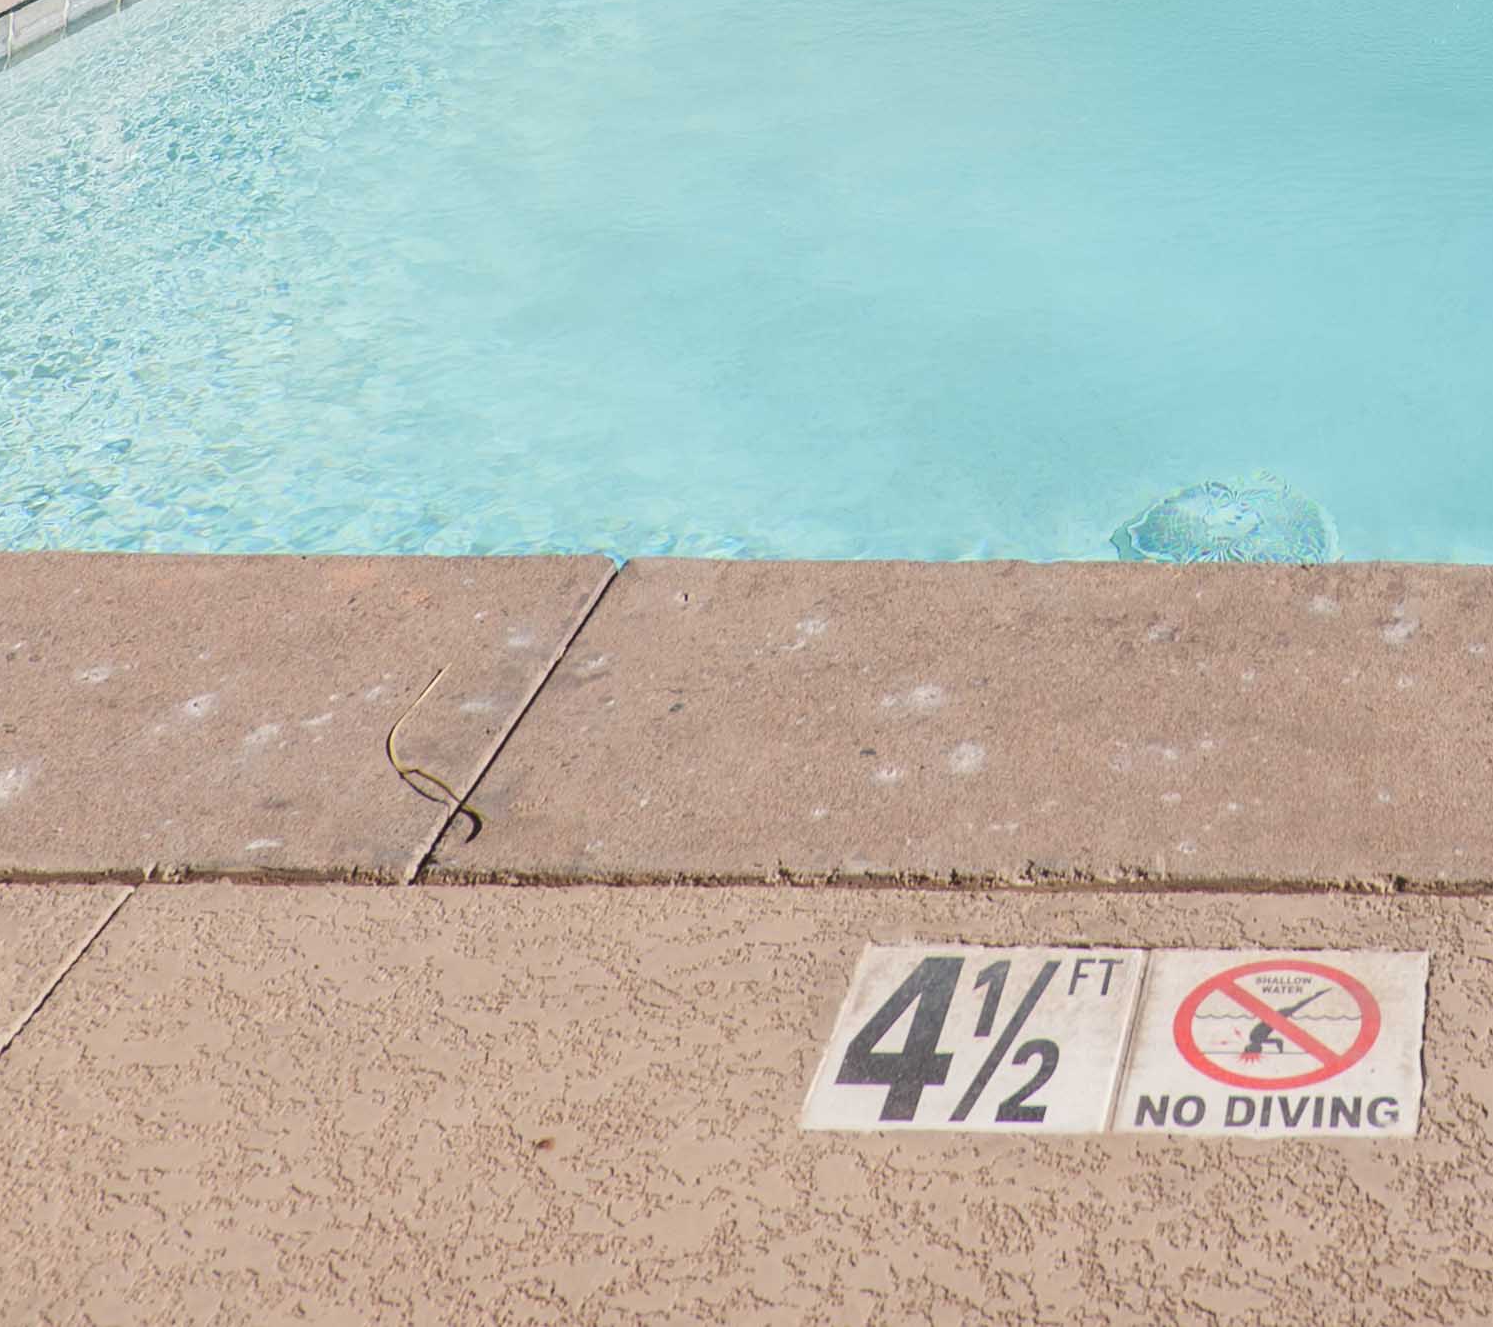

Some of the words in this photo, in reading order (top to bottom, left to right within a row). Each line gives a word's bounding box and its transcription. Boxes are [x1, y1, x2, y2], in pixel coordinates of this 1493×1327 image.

[1068, 958, 1123, 996] FT
[1255, 976, 1312, 985] SHALLOW
[1262, 986, 1303, 994] WATER
[1134, 1095, 1206, 1128] NO
[1223, 1095, 1400, 1129] DIVING
